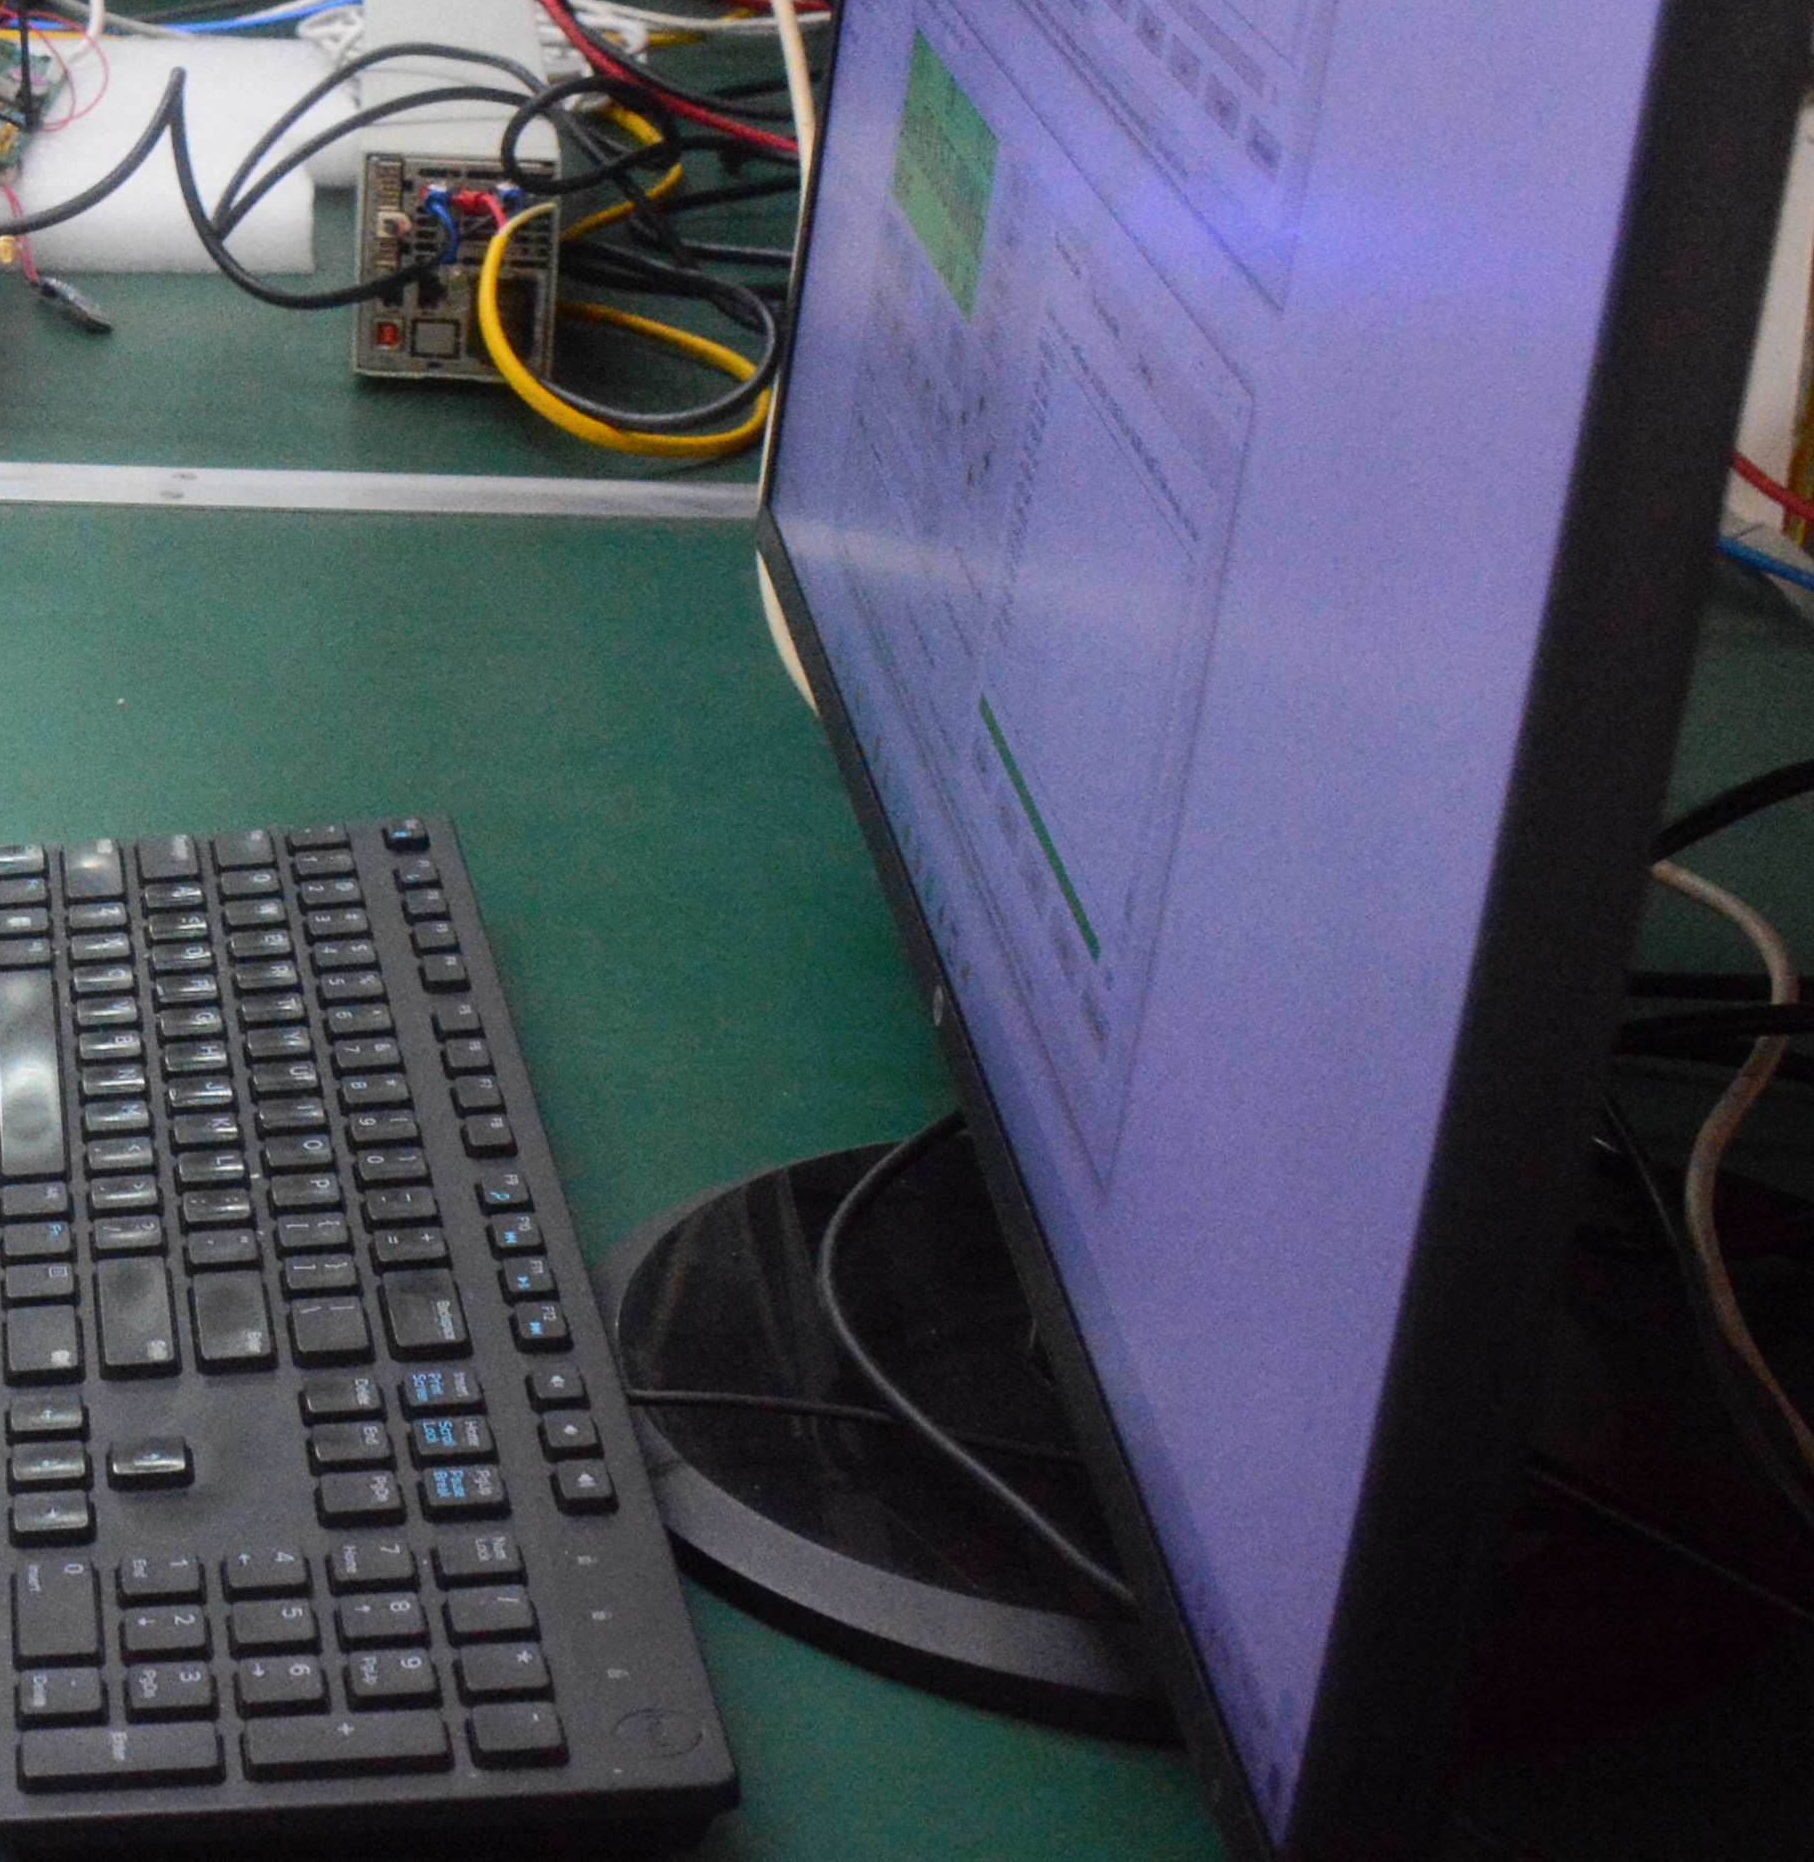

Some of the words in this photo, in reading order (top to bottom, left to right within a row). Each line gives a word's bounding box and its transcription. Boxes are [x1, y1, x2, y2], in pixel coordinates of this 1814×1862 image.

[308, 884, 325, 893] 2
[315, 914, 331, 923] 3
[322, 945, 339, 955] 4
[328, 977, 345, 987] 5
[335, 1010, 354, 1020] 6
[200, 1044, 220, 1056] H
[343, 1044, 361, 1054] 7
[289, 1066, 310, 1079] U
[350, 1080, 368, 1090] 8
[211, 1116, 230, 1129] K
[358, 1116, 377, 1127] 9
[302, 1139, 324, 1151] O
[216, 1154, 235, 1166] L
[366, 1154, 385, 1165] 0
[309, 1178, 331, 1189] P
[528, 1258, 545, 1275] F11
[541, 1305, 558, 1321] F12
[362, 1425, 380, 1446] End
[422, 1420, 438, 1445] Lock
[438, 1420, 458, 1448] Scroll
[464, 1420, 481, 1448] Home
[370, 1475, 388, 1503] PgDn
[432, 1469, 453, 1499] Break
[449, 1469, 466, 1499] Pause
[380, 1543, 401, 1555] 7
[474, 1537, 492, 1562] Lock
[490, 1535, 508, 1561] Num
[169, 1557, 189, 1569] 1
[274, 1550, 295, 1564] 4
[342, 1544, 357, 1575] Home
[63, 1562, 85, 1575] 0
[132, 1558, 148, 1579] End
[389, 1598, 412, 1613] 8
[173, 1614, 196, 1626] 2
[281, 1607, 304, 1620] 5
[289, 1662, 311, 1677] 6
[399, 1656, 423, 1670] 9
[178, 1670, 202, 1684] 3
[138, 1668, 159, 1700] PgDn
[336, 1721, 356, 1737] +
